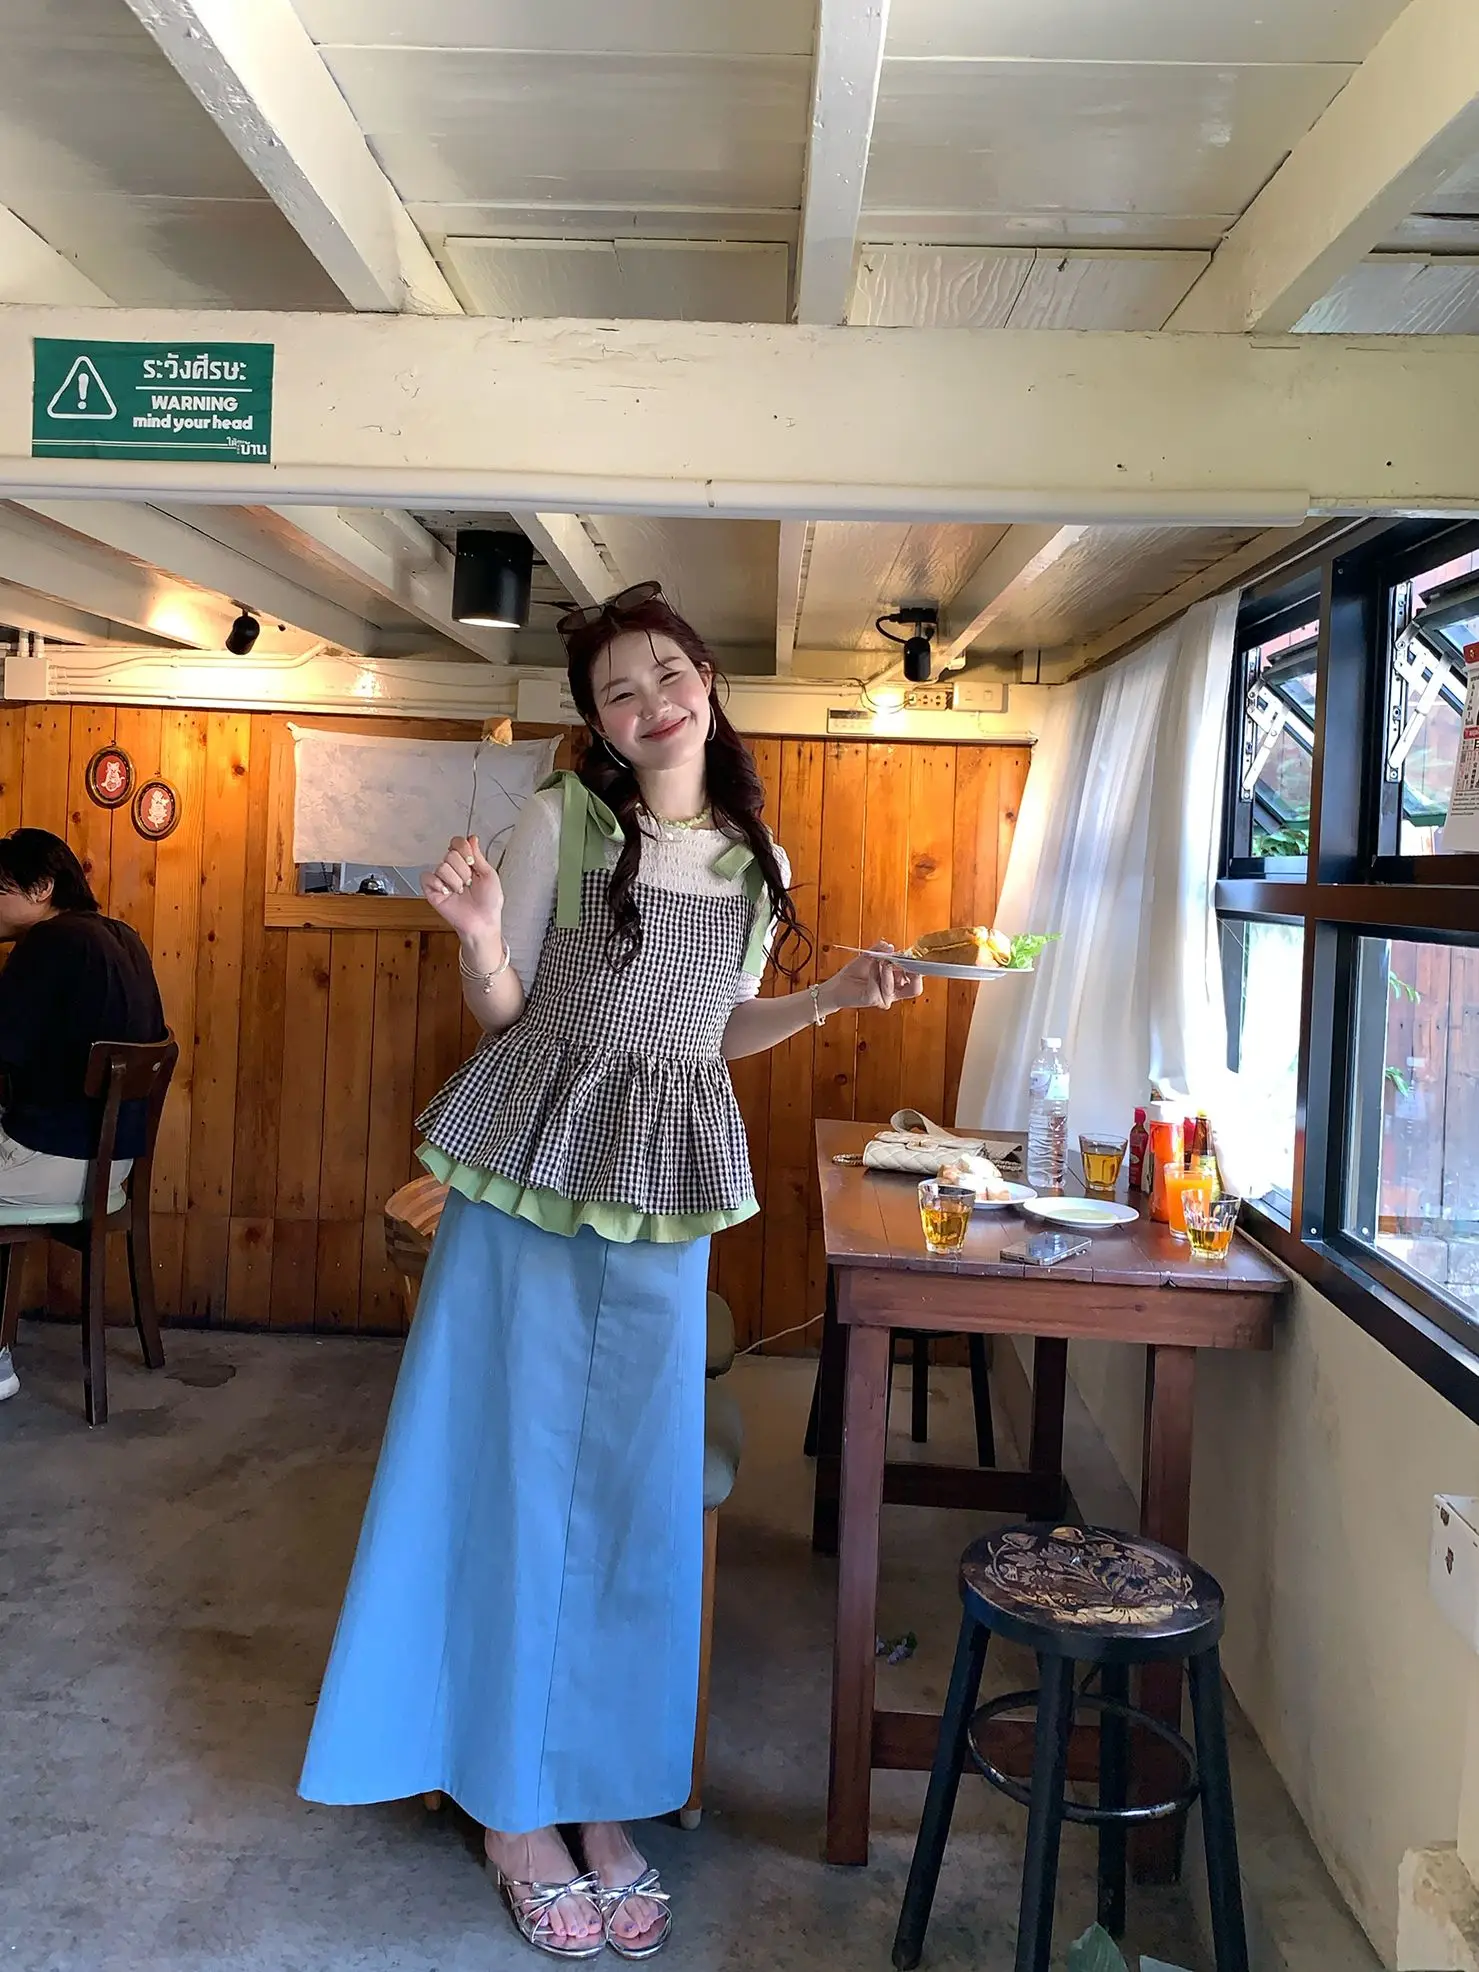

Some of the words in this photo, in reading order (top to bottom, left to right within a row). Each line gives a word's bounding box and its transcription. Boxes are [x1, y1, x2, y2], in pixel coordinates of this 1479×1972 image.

[143, 353, 247, 381] ระวังศีรษะ
[151, 395, 238, 412] WARNING
[132, 413, 172, 428] mind
[173, 417, 211, 433] your
[212, 414, 253, 431] head
